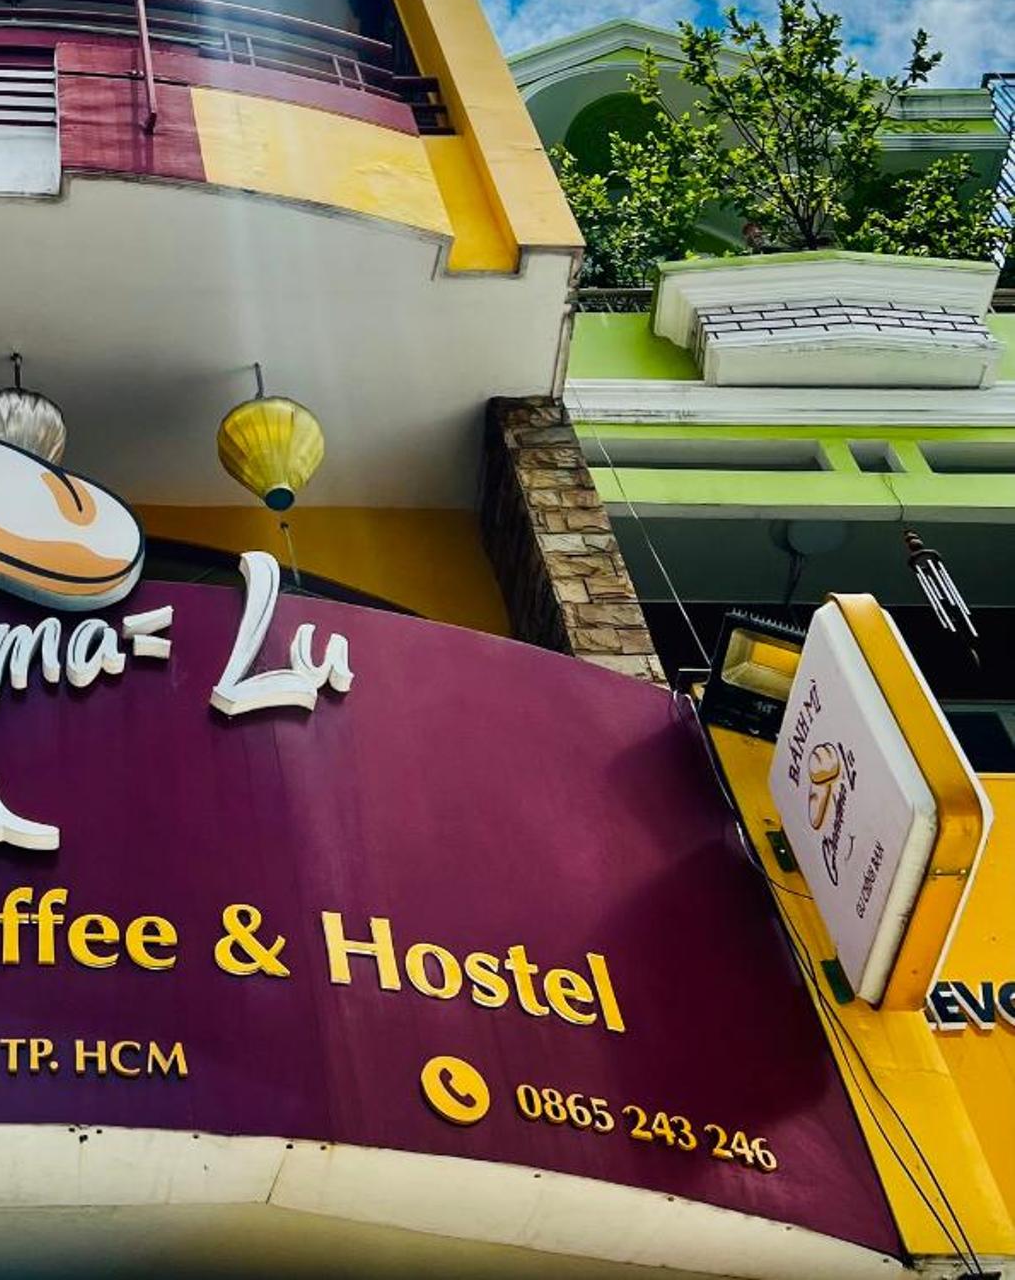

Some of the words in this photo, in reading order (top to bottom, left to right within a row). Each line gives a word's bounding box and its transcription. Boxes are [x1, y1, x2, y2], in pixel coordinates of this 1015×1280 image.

[211, 551, 354, 715] Lu
[215, 904, 290, 976] &
[322, 912, 625, 1032] Hostel
[0, 1038, 59, 1071] TP.
[76, 1040, 188, 1075] HCM
[517, 1085, 615, 1132] 0865
[623, 1106, 697, 1151] 243
[705, 1124, 778, 1171] 246
